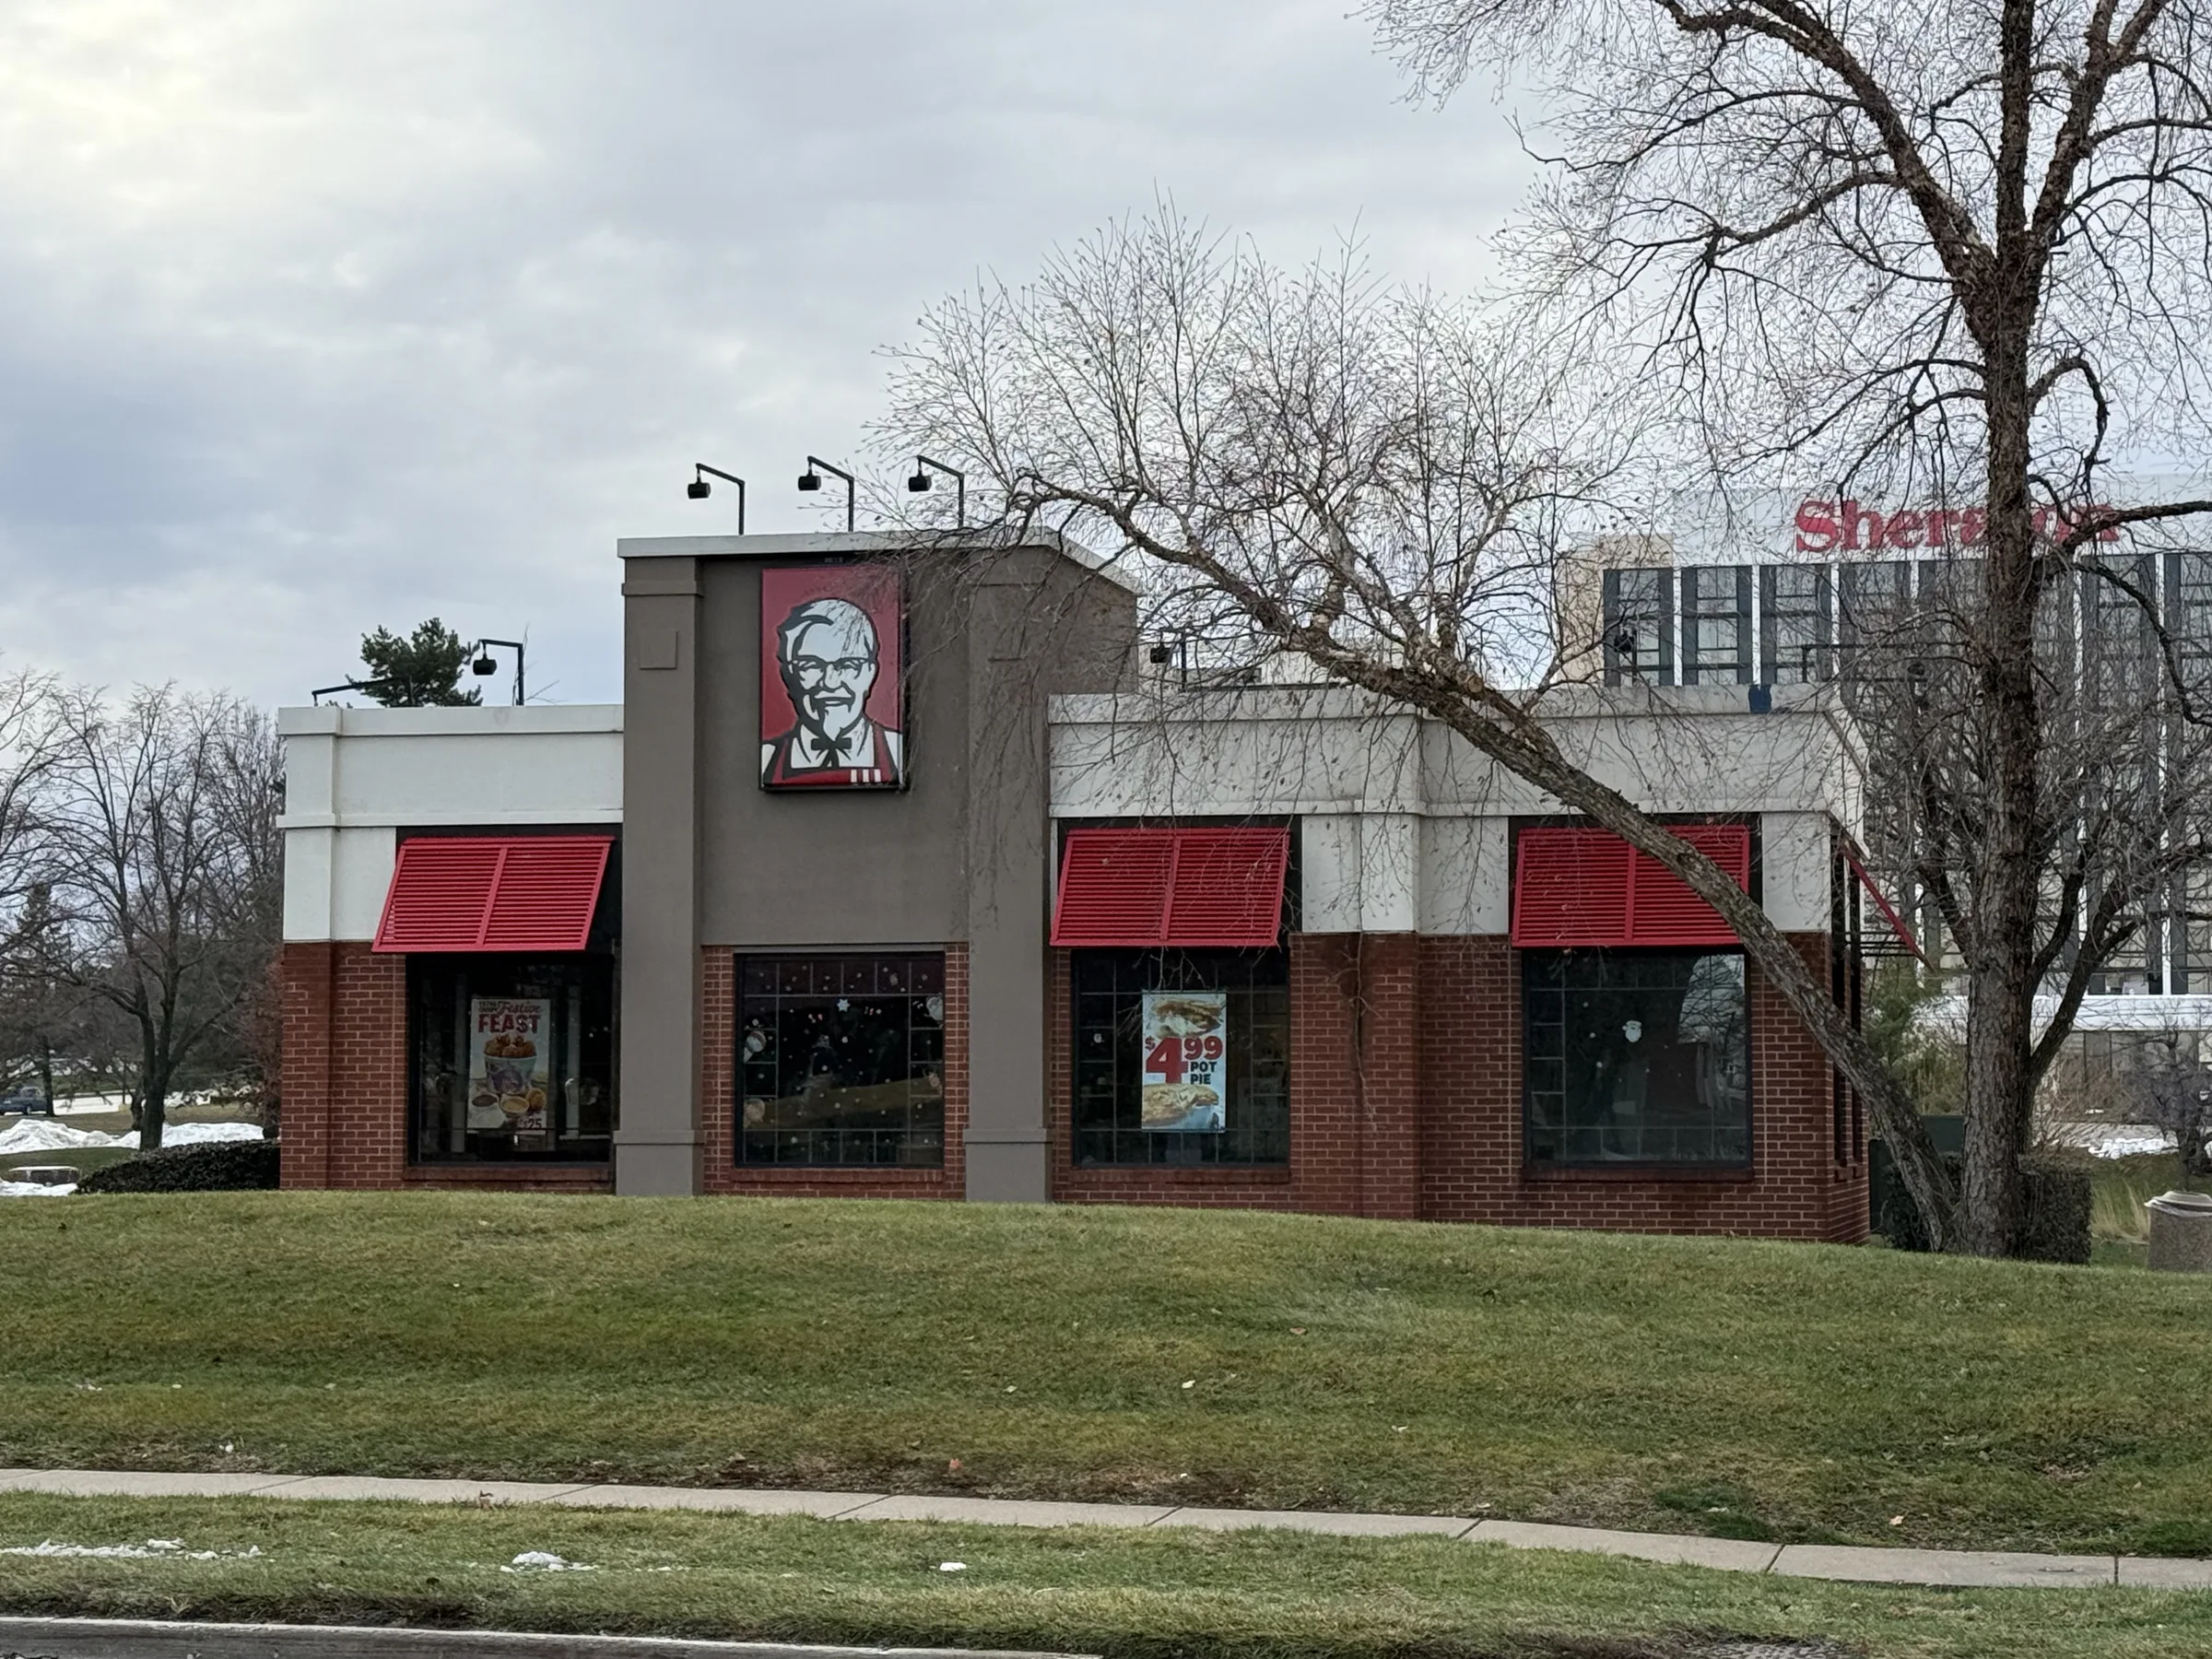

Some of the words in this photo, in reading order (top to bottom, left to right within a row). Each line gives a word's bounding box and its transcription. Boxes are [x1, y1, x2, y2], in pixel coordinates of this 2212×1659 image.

[1795, 499, 2119, 552] Sheraon
[477, 1014, 541, 1034] FEAST
[1190, 1061, 1218, 1073] POT
[1190, 1074, 1211, 1085] PIE
